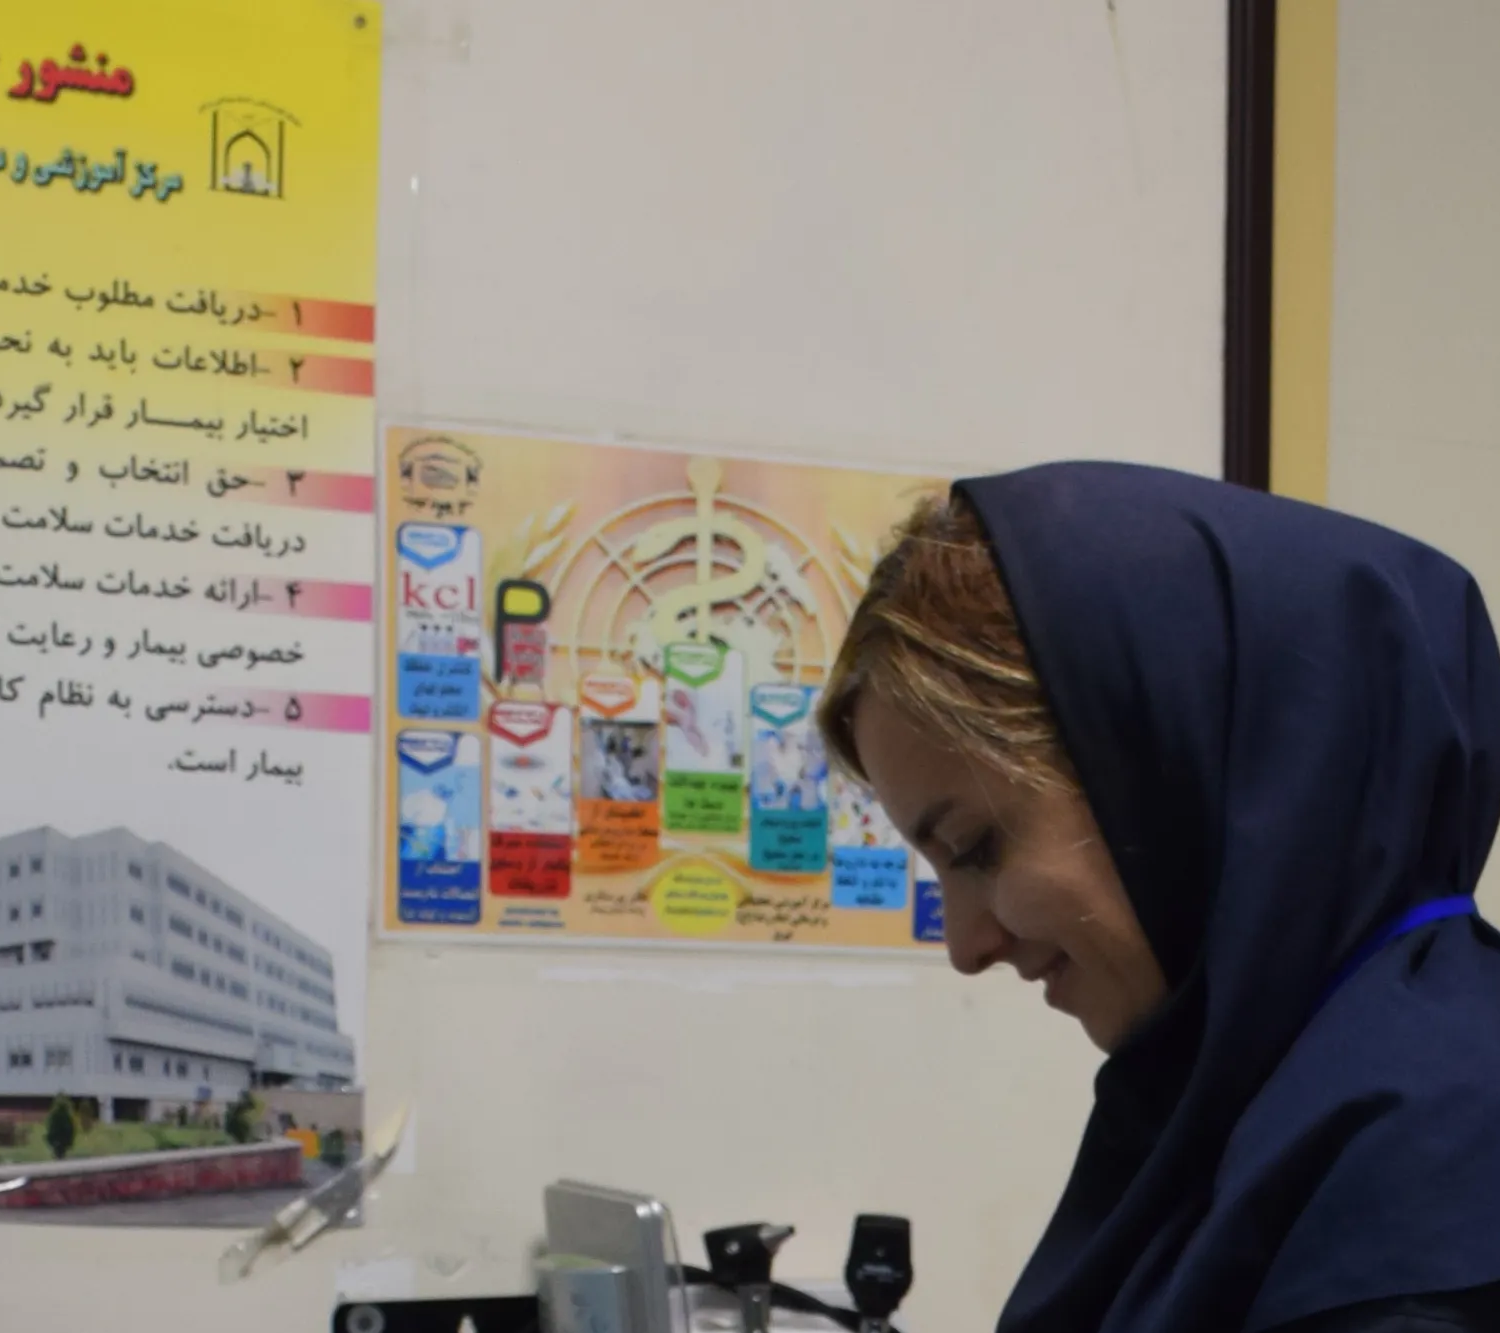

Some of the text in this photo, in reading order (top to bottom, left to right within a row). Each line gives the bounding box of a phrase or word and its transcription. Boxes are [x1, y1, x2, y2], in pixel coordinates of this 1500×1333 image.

[7, 40, 135, 102] منشور
[11, 149, 29, 182] و
[32, 147, 128, 190] آموزشی
[128, 159, 185, 203] مرکز
[63, 279, 156, 314] مطلوب
[46, 337, 73, 368] به
[87, 337, 138, 375] باید
[63, 391, 116, 429] قرار
[124, 397, 225, 441] بیمار
[234, 409, 309, 444] اختیار
[65, 460, 81, 484] و
[98, 454, 190, 489] انتخاب
[0, 505, 94, 535] سلامت
[103, 512, 201, 544] خدمات
[210, 522, 307, 559] دریافت
[95, 569, 193, 600] خدمات
[401, 569, 476, 610] kcl
[6, 620, 94, 657] رعایت
[103, 636, 117, 660] و
[126, 627, 187, 666] بیمار
[196, 641, 305, 671] خصوصی
[38, 679, 95, 720] نظام
[106, 689, 132, 719] به
[167, 747, 304, 787] بیمار است.
